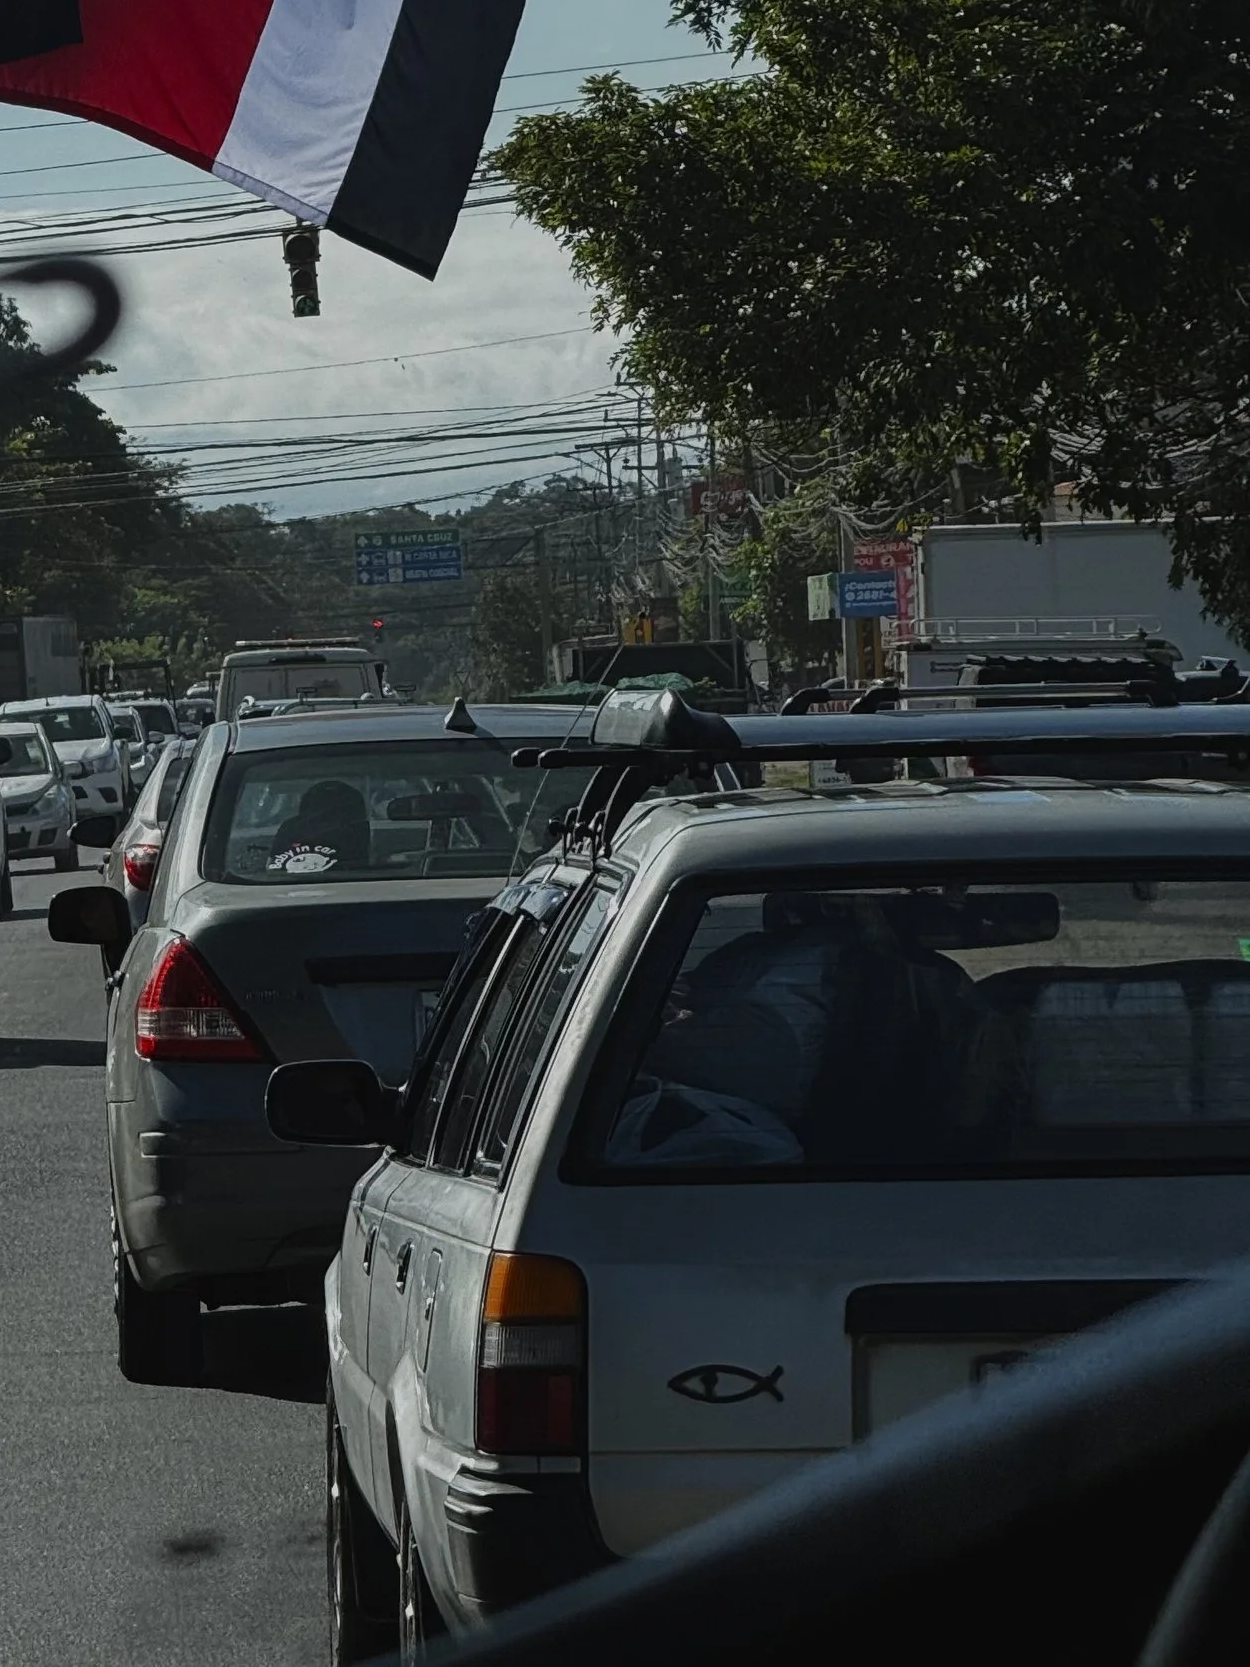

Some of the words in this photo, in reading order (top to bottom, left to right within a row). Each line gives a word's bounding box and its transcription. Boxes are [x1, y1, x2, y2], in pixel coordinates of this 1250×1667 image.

[390, 534, 424, 545] SANTA
[427, 533, 453, 543] CRUZ
[845, 581, 896, 592] ¡Contact
[268, 848, 294, 870] Baby
[314, 845, 336, 855] car
